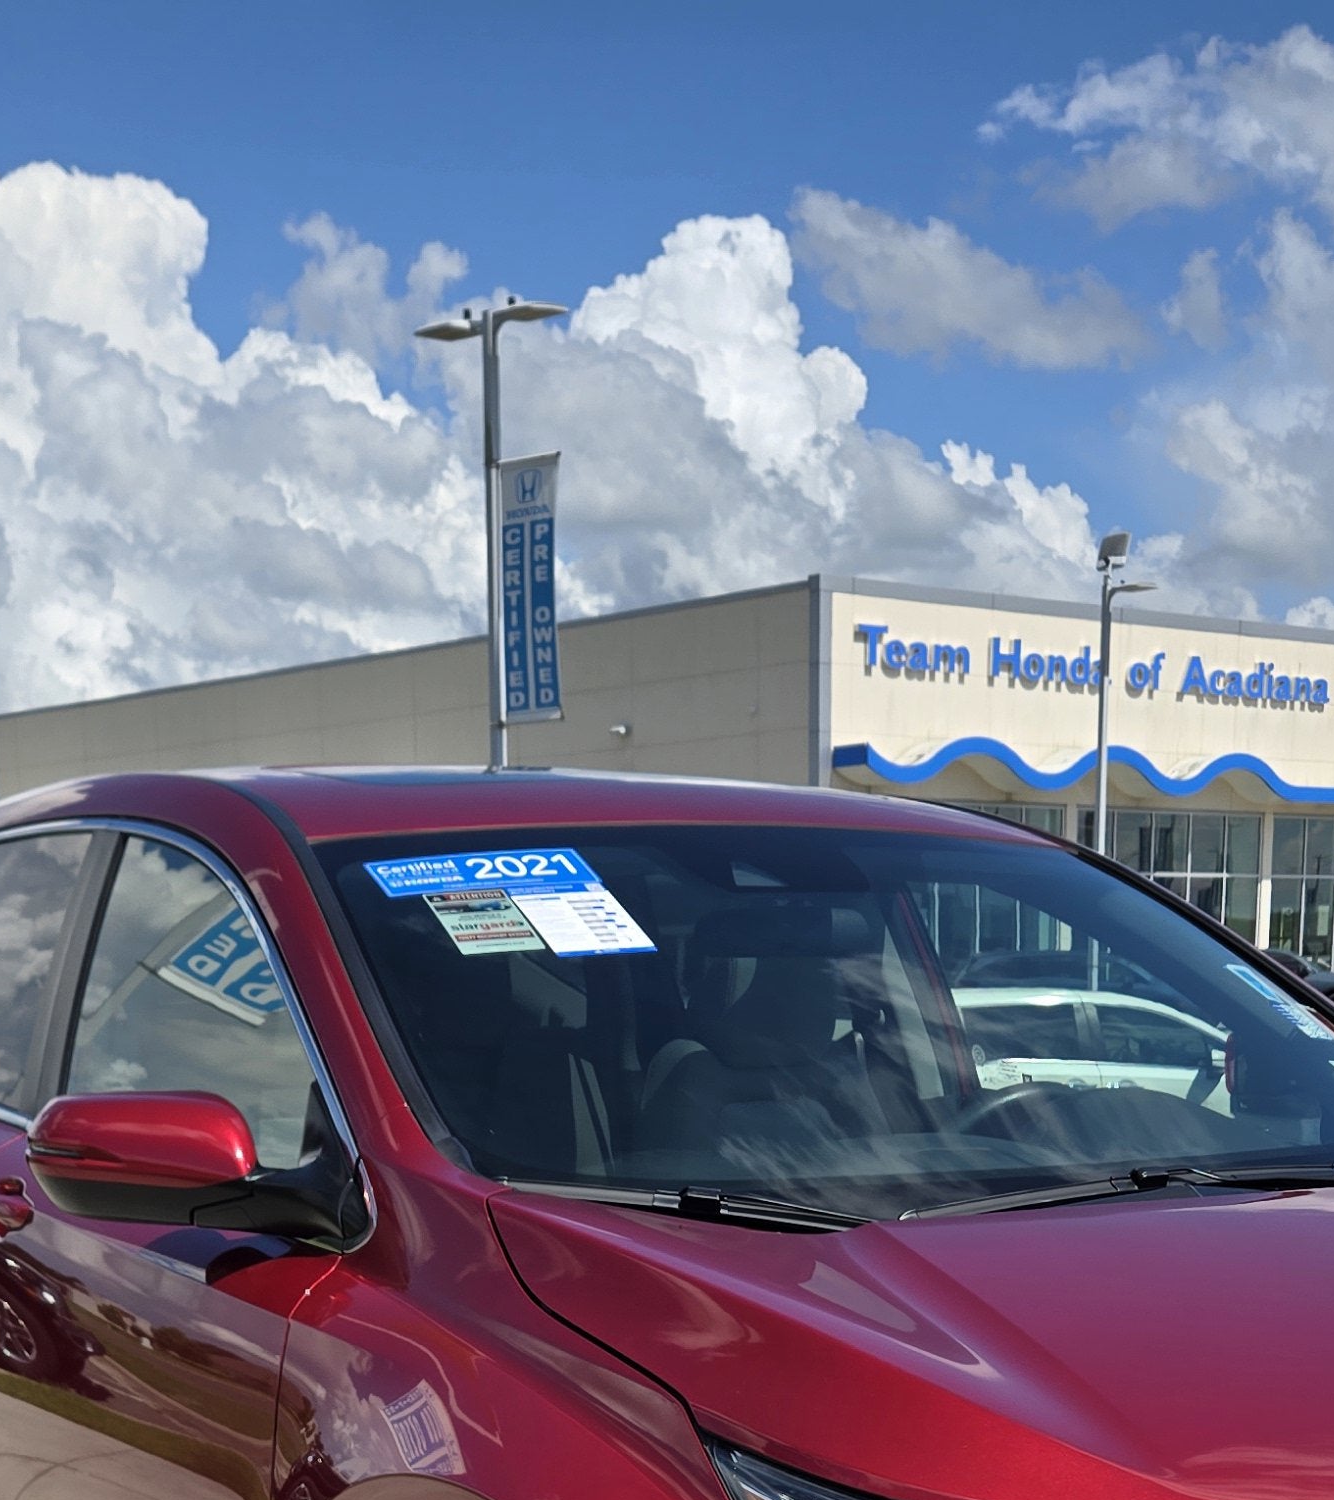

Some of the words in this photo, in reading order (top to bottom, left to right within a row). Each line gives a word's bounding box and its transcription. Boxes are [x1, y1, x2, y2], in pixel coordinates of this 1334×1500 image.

[533, 523, 549, 582] PRE
[505, 527, 525, 708] CERTIFIED
[533, 606, 554, 705] OWNED
[856, 622, 970, 675] Team
[1129, 652, 1165, 690] of
[1180, 656, 1330, 704] Acadiana
[376, 860, 456, 874] Certified
[465, 853, 578, 880] 2021
